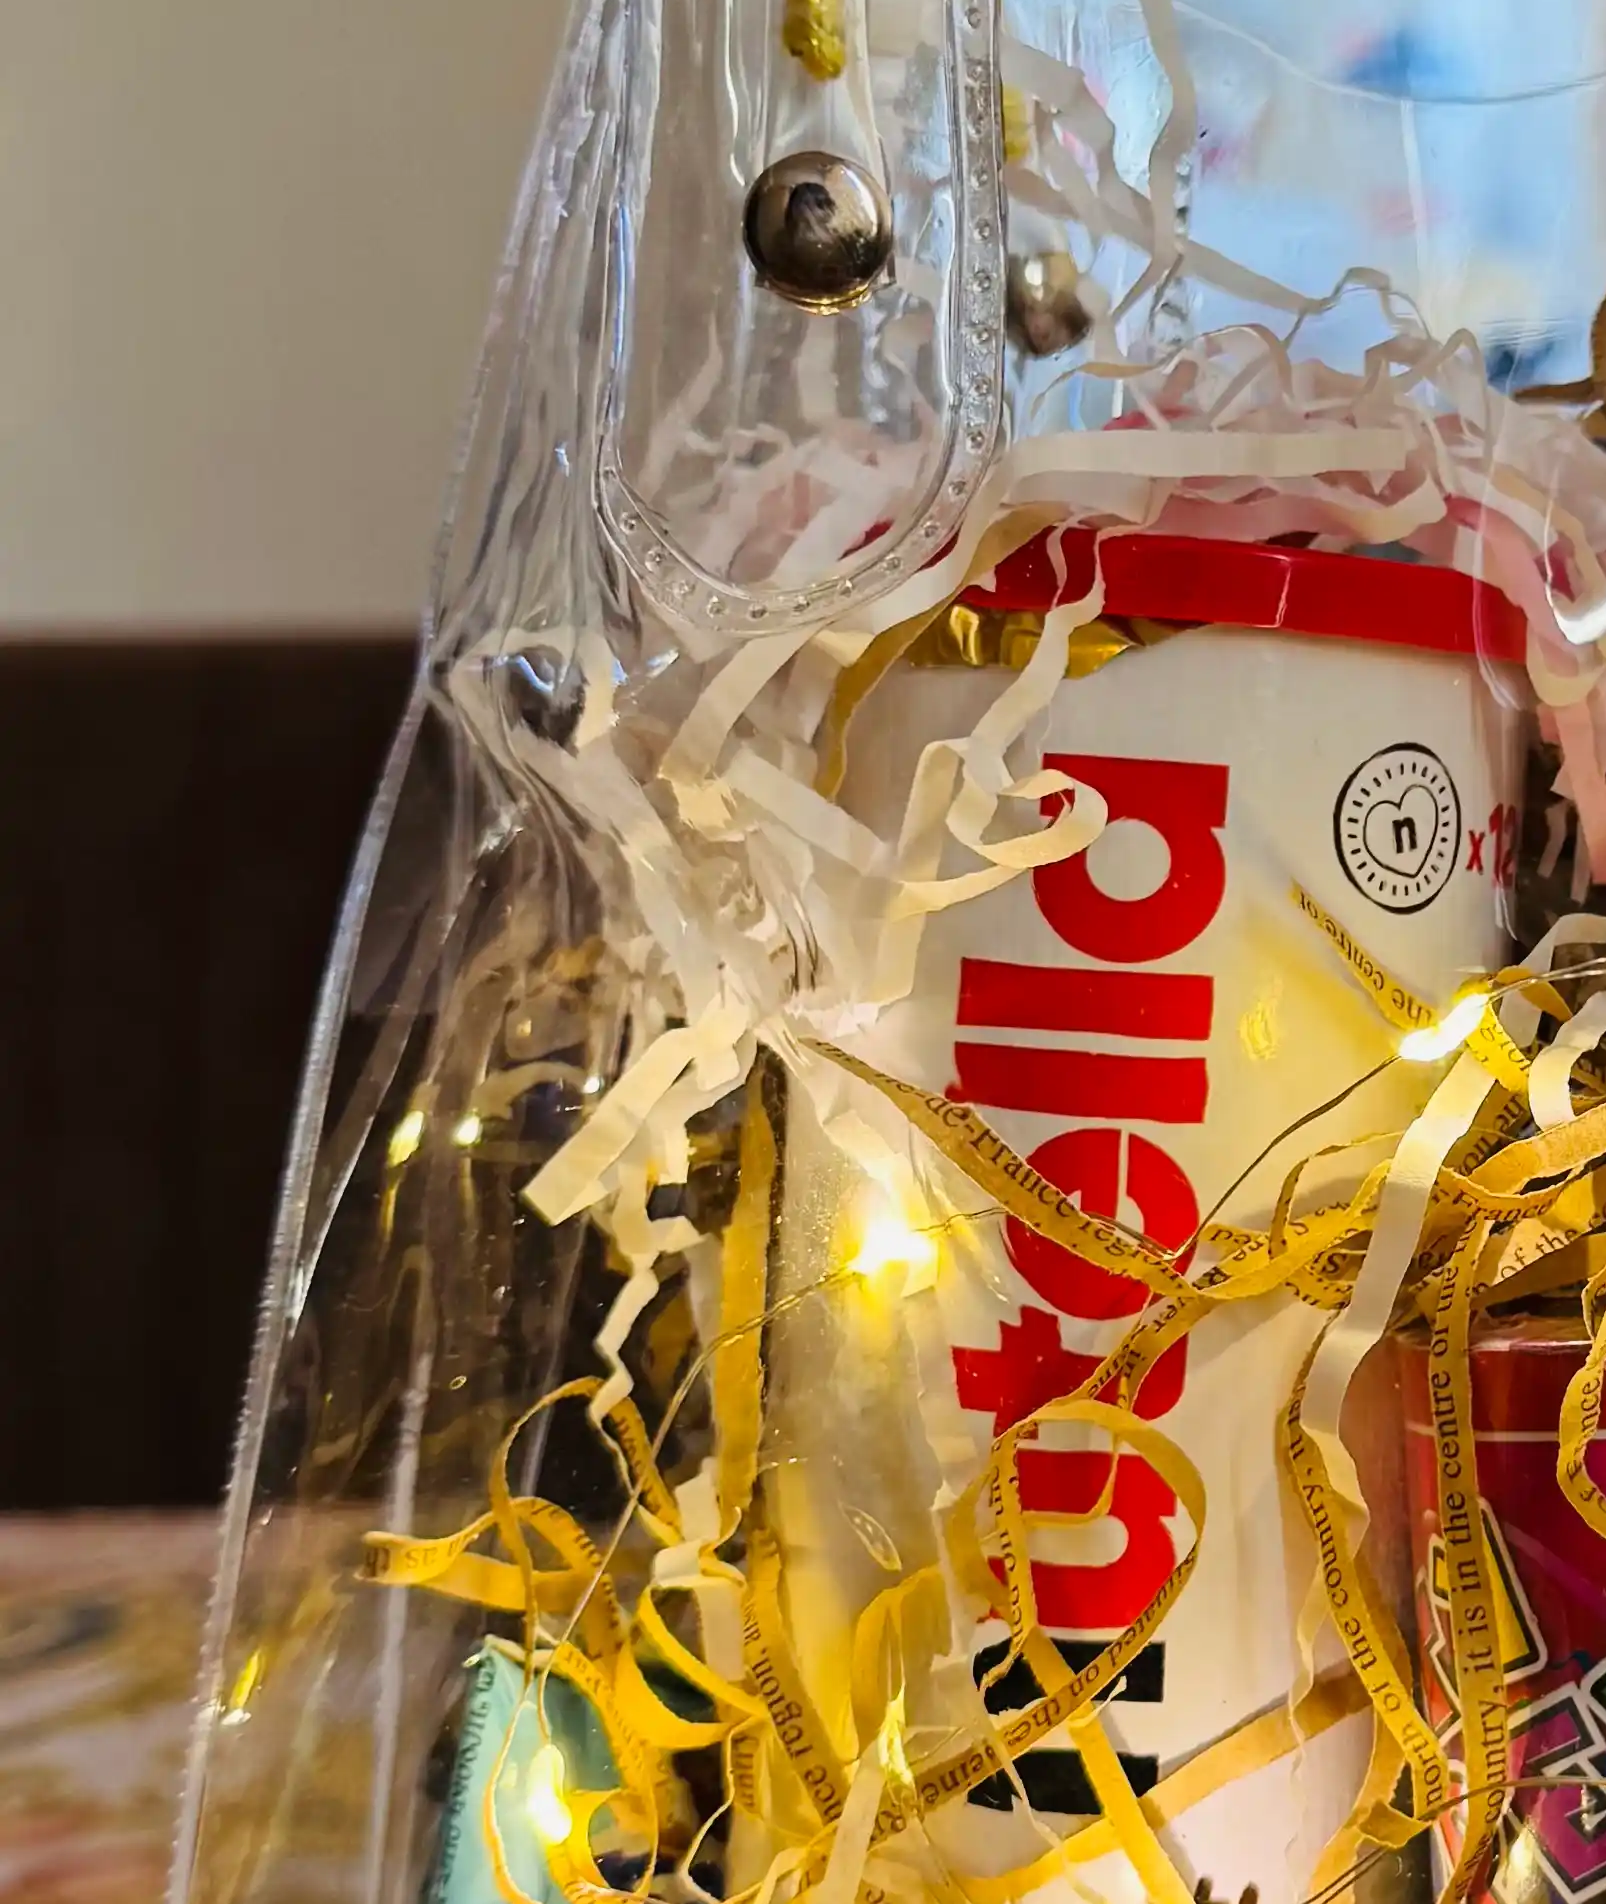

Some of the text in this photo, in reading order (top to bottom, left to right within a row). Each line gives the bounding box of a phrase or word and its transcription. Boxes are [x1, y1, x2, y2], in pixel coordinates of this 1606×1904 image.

[1391, 816, 1418, 854] n
[1430, 1369, 1471, 1480] centre
[1441, 1488, 1471, 1547] the
[1450, 1553, 1482, 1591] in
[1455, 1603, 1490, 1638] is
[1069, 1658, 1106, 1692] on
[1357, 1642, 1384, 1683] the
[1461, 1644, 1496, 1677] it
[1004, 1699, 1064, 1748] the
[1381, 1689, 1412, 1723] of
[1410, 1736, 1449, 1815] north
